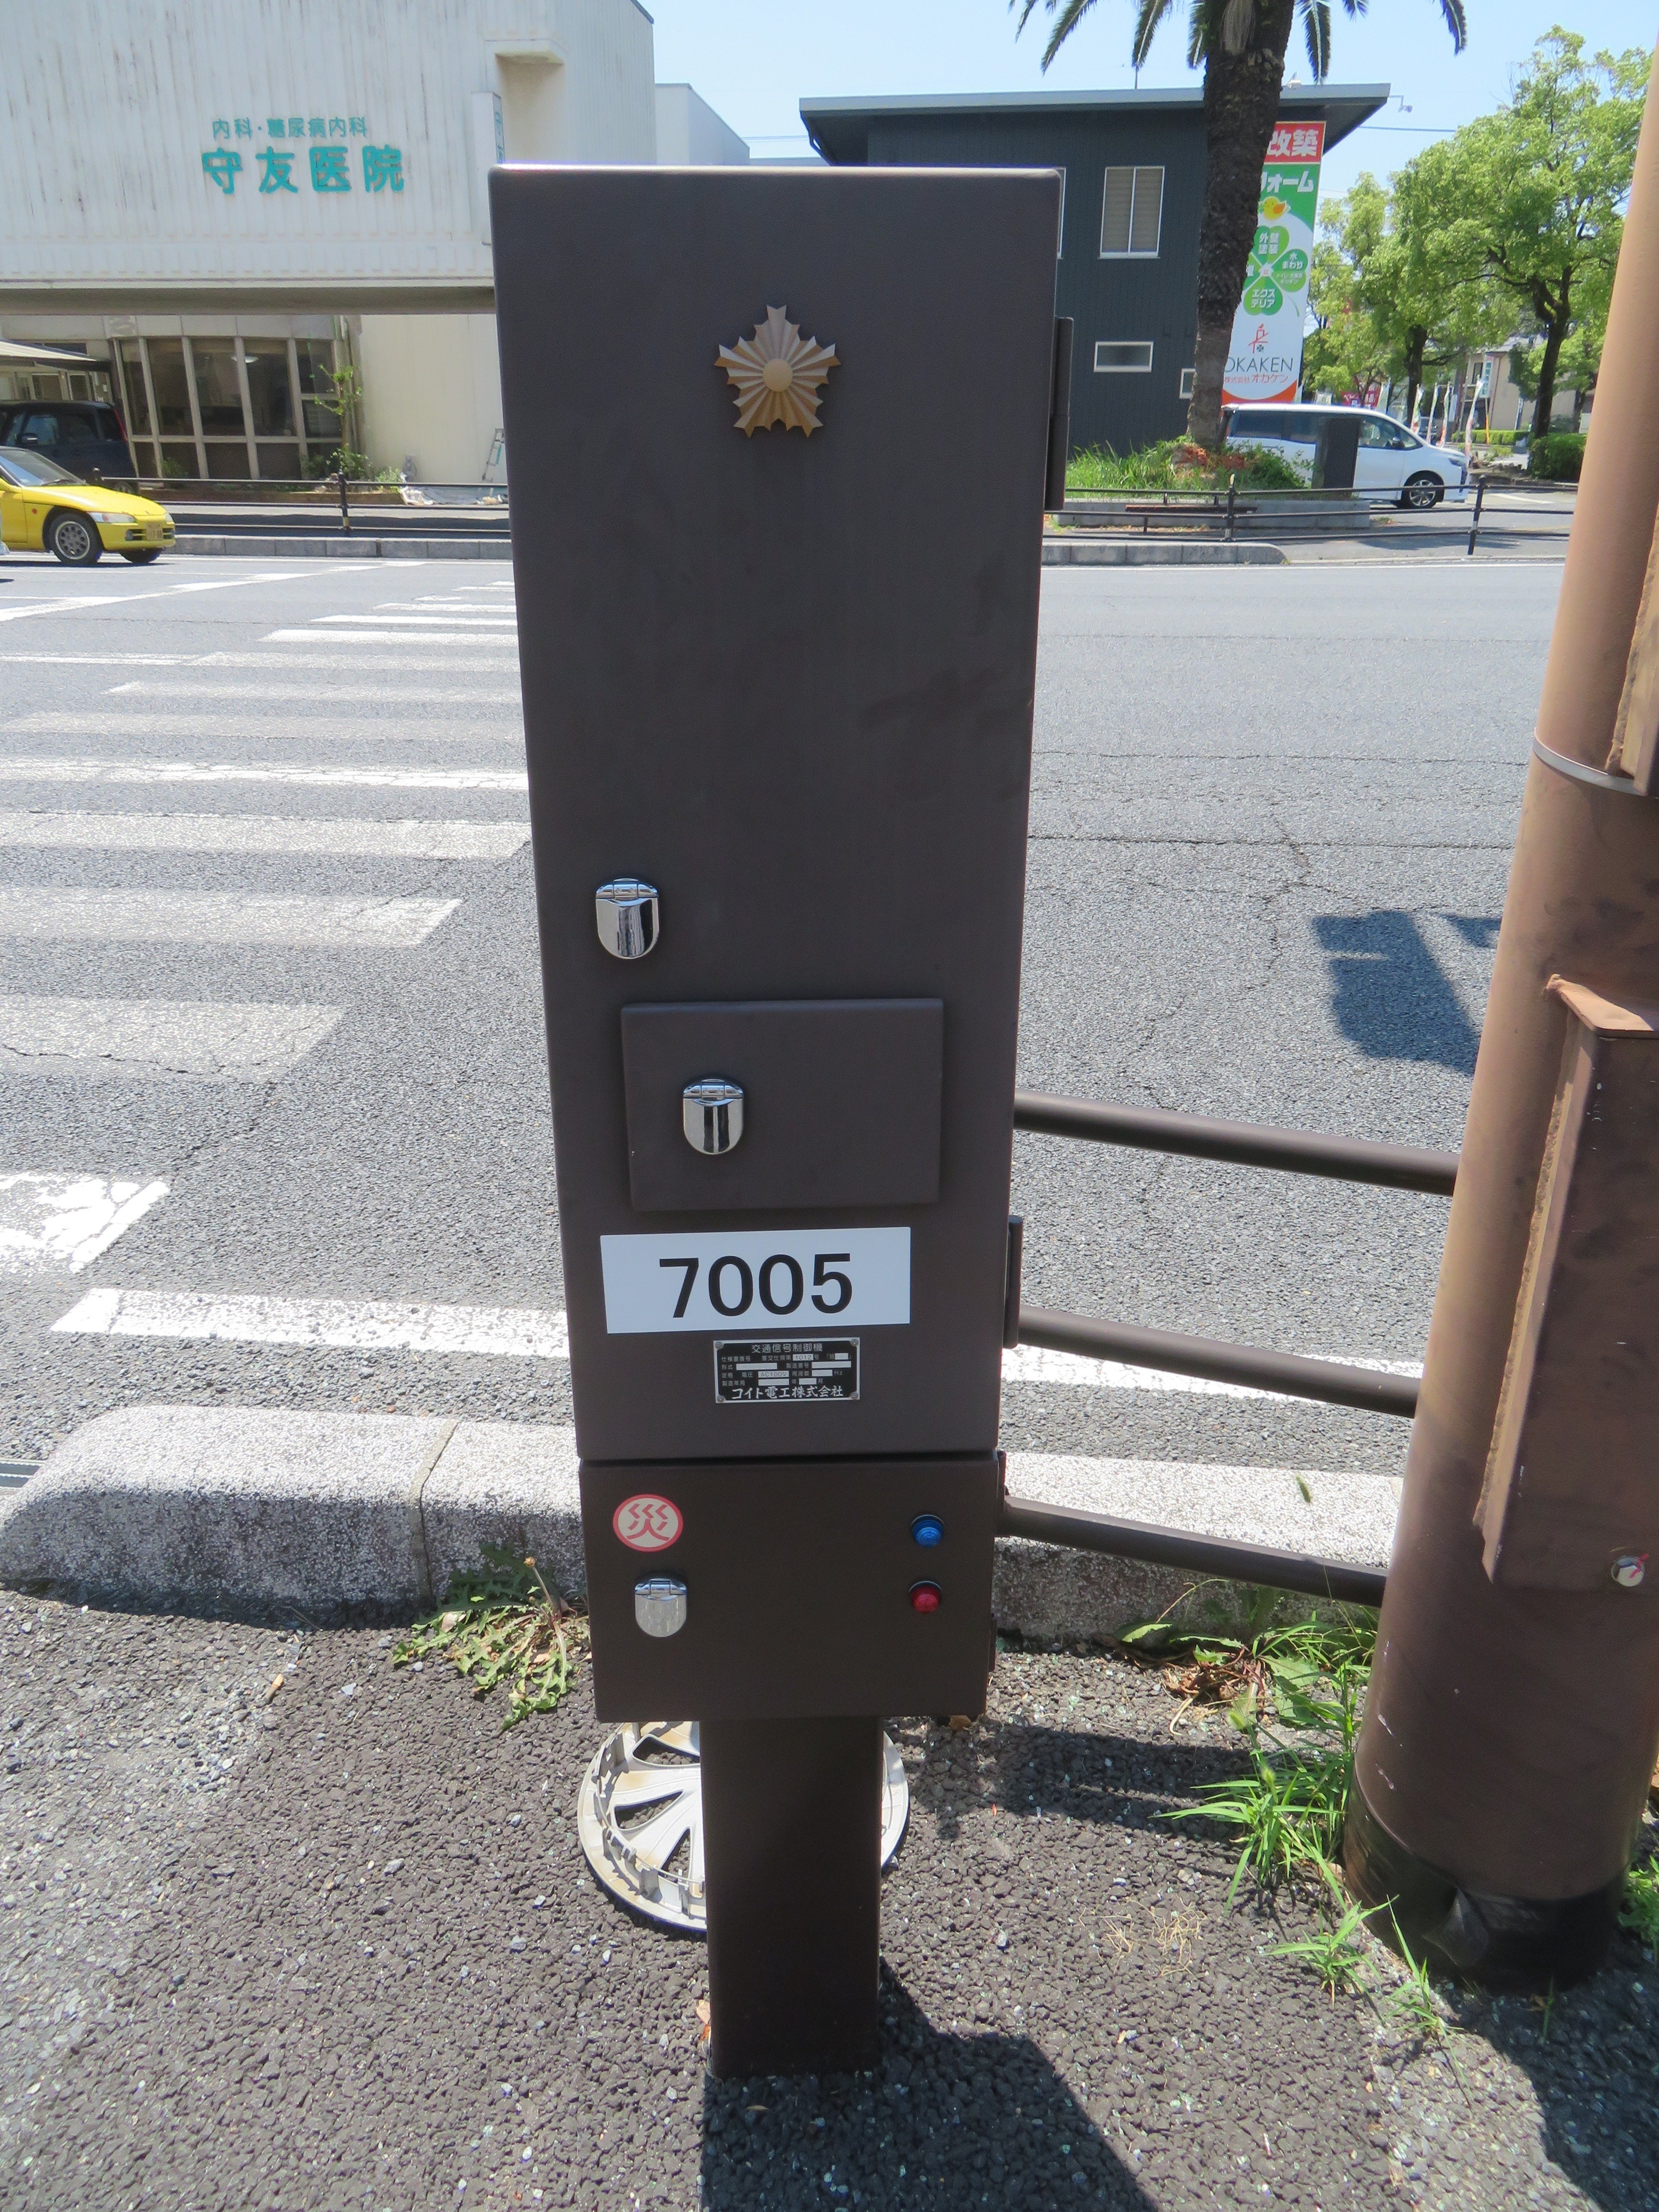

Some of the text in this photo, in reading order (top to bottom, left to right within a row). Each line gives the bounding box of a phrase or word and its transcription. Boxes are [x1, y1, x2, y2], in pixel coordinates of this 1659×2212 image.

[212, 116, 367, 141] 内科・糖尿病内科
[1266, 129, 1319, 157] 改築
[201, 144, 405, 195] 守友医院
[1259, 232, 1280, 243] 外壁
[1289, 252, 1298, 261] 水
[1282, 261, 1304, 270] まわり
[1252, 288, 1276, 298] エクス
[1252, 299, 1275, 309] テリア
[1224, 357, 1293, 373] OKAKEN
[659, 1253, 853, 1318] 7005
[751, 1343, 823, 1353] 交通信号制御機
[732, 1385, 844, 1399] コイト電工株式会社
